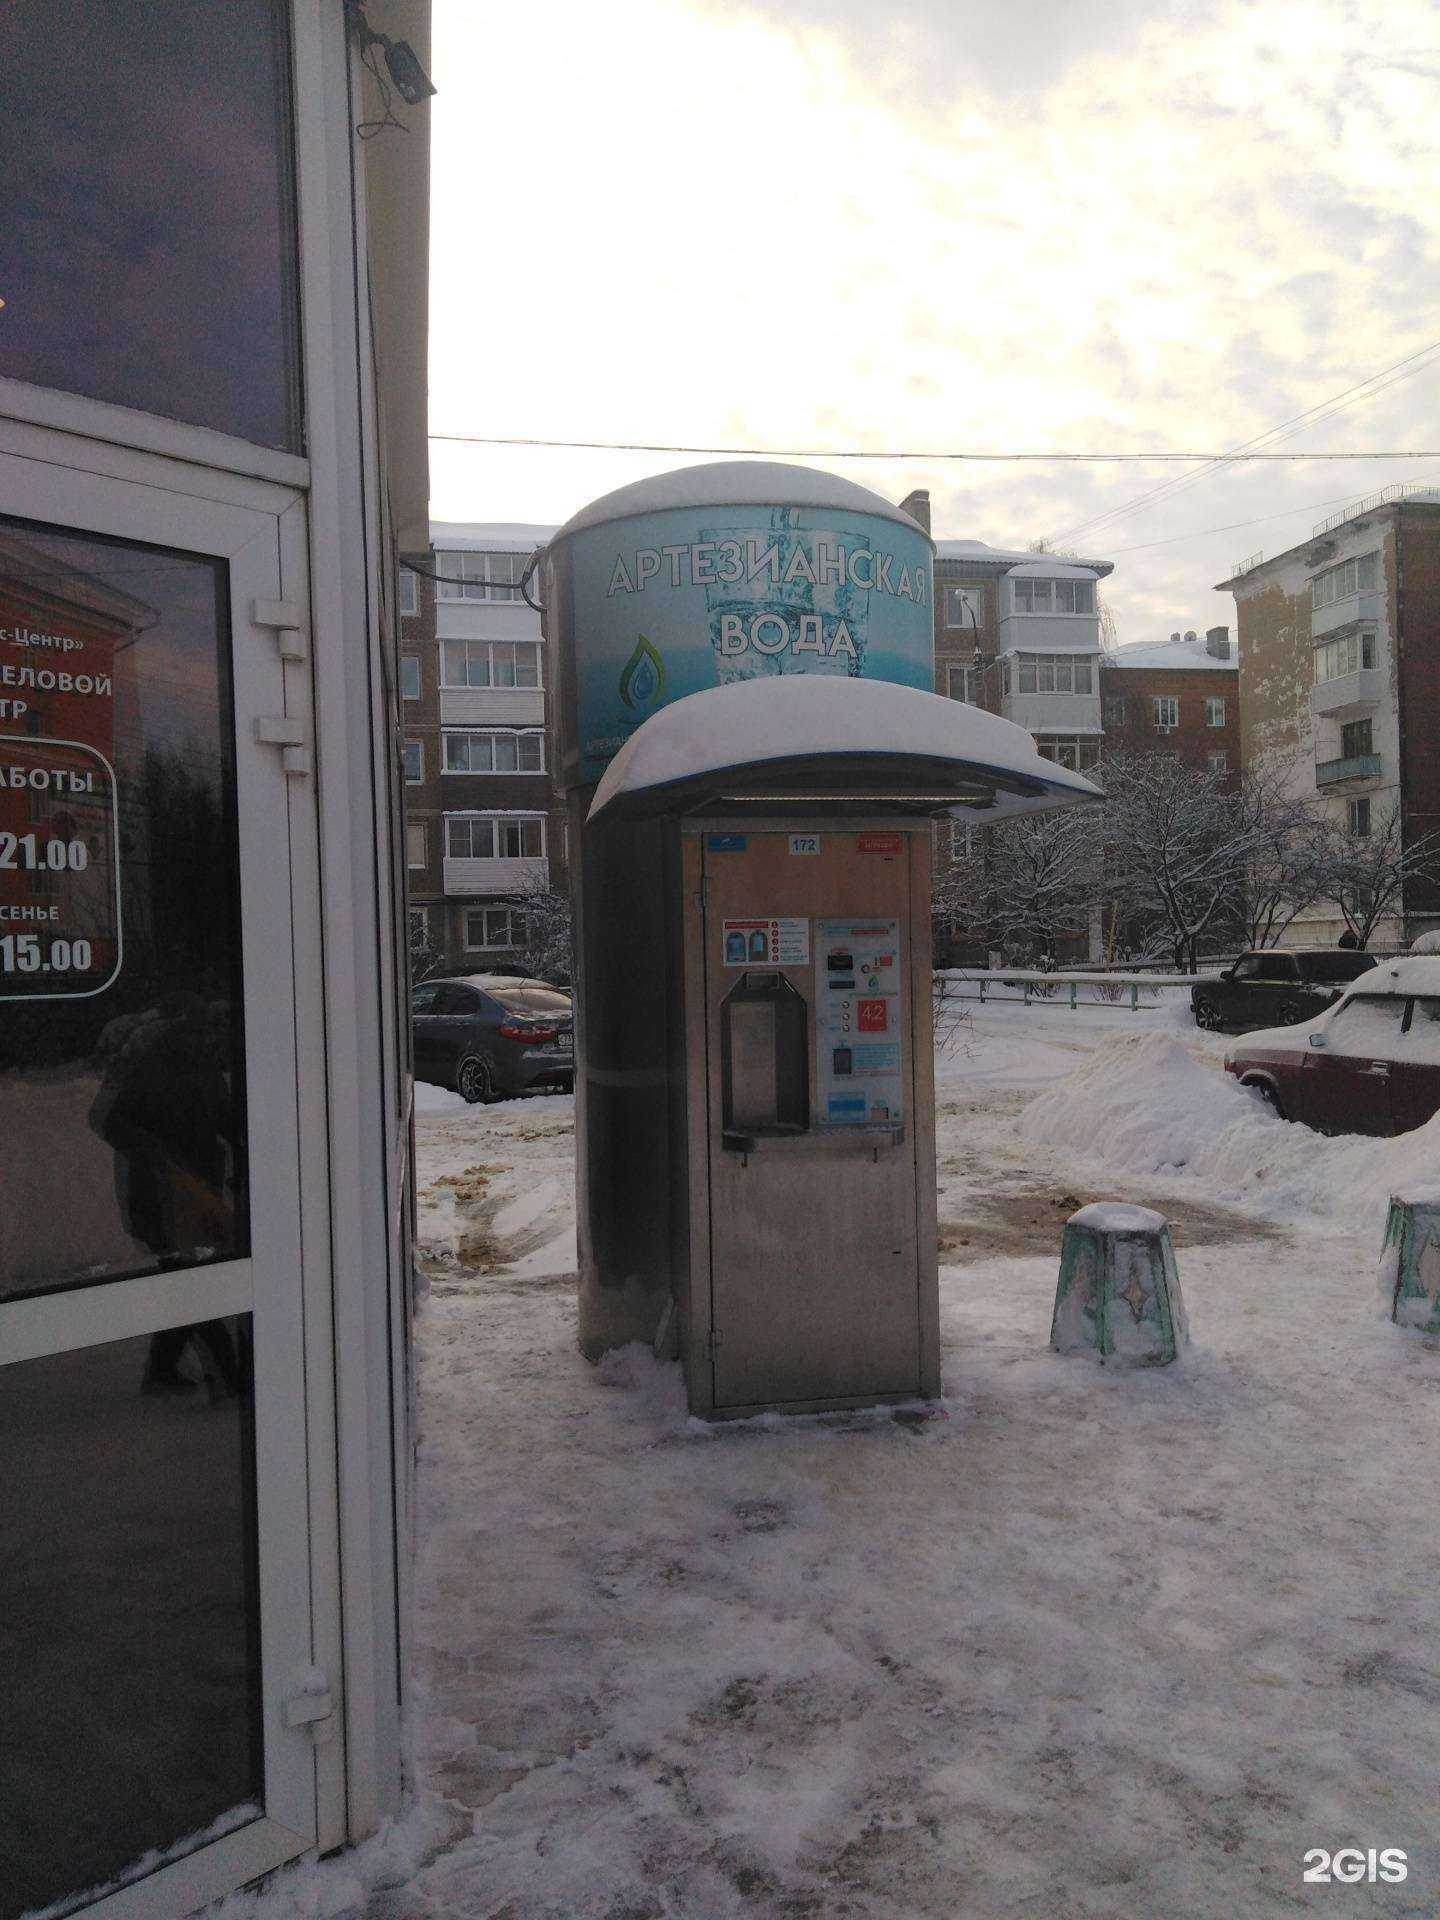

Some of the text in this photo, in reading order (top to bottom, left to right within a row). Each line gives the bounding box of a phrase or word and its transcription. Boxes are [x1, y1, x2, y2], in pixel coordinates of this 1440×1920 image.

[607, 540, 926, 604] АРТЕЗИАНСКАЯ
[720, 613, 858, 658] ВОДА
[0, 832, 88, 871] 21.00
[793, 839, 816, 851] 172
[0, 934, 92, 972] 15.00
